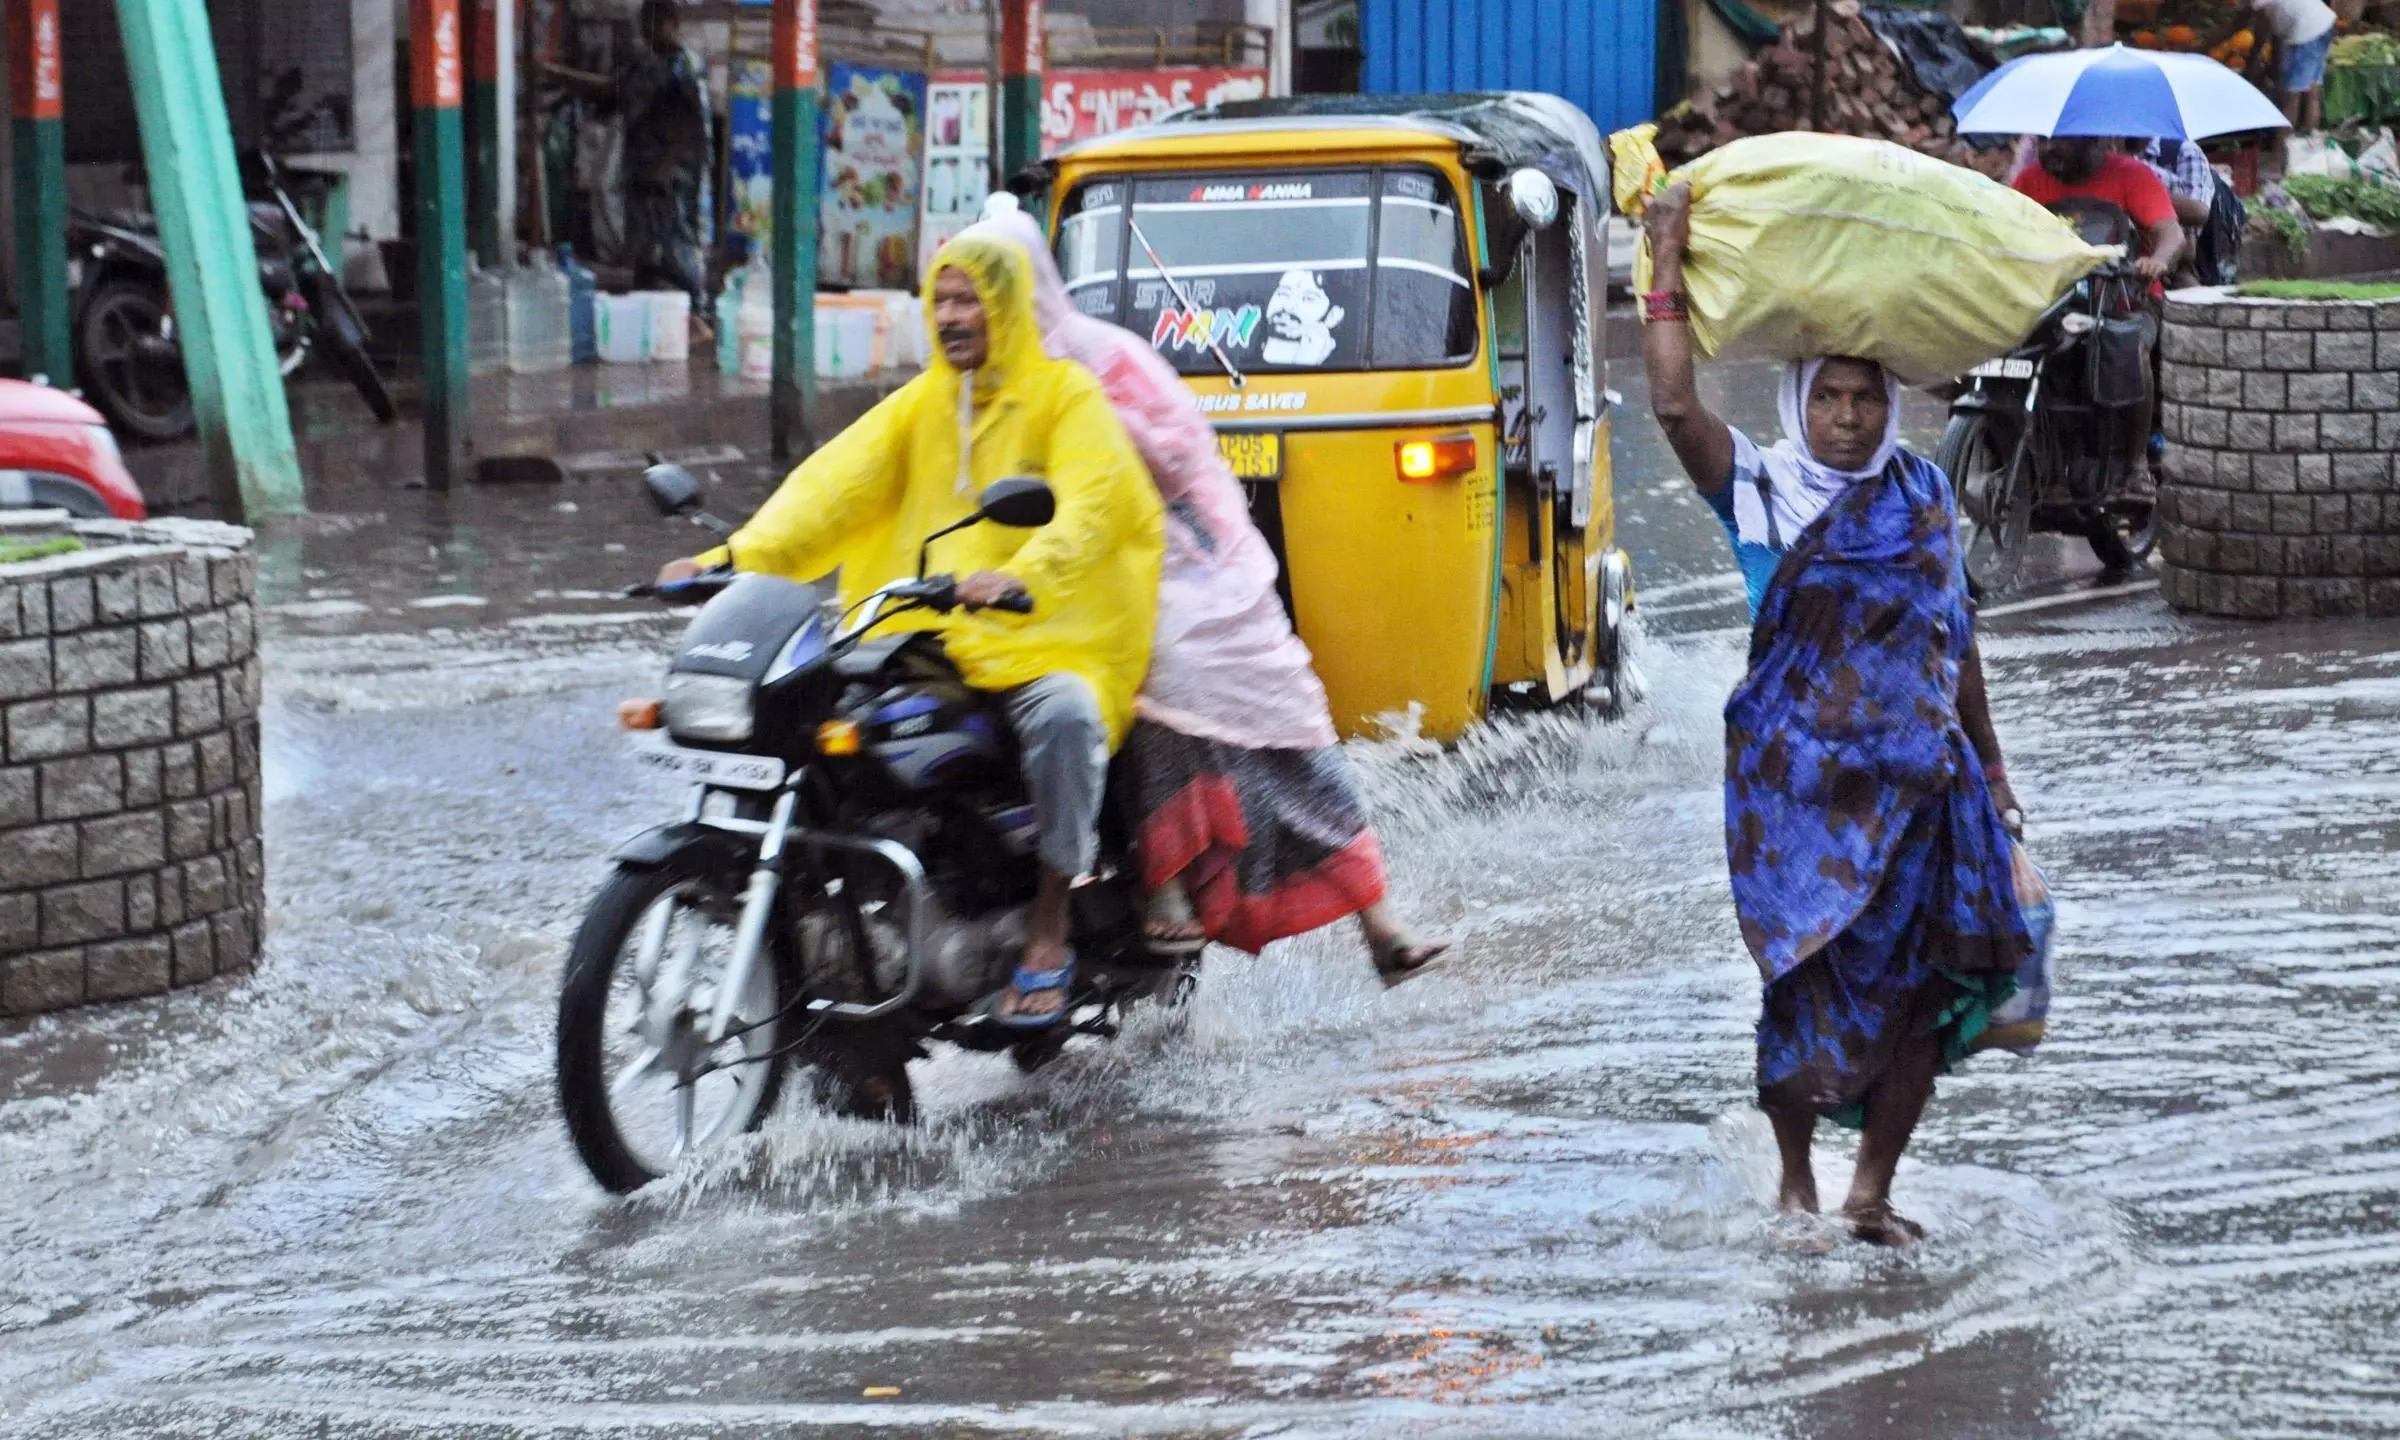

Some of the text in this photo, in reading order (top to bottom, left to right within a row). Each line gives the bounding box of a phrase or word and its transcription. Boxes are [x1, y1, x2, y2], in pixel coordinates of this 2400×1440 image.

[1189, 183, 1312, 202] AMMA NANNA
[1134, 278, 1216, 311] STAR
[1195, 391, 1307, 412] SUS SAVES
